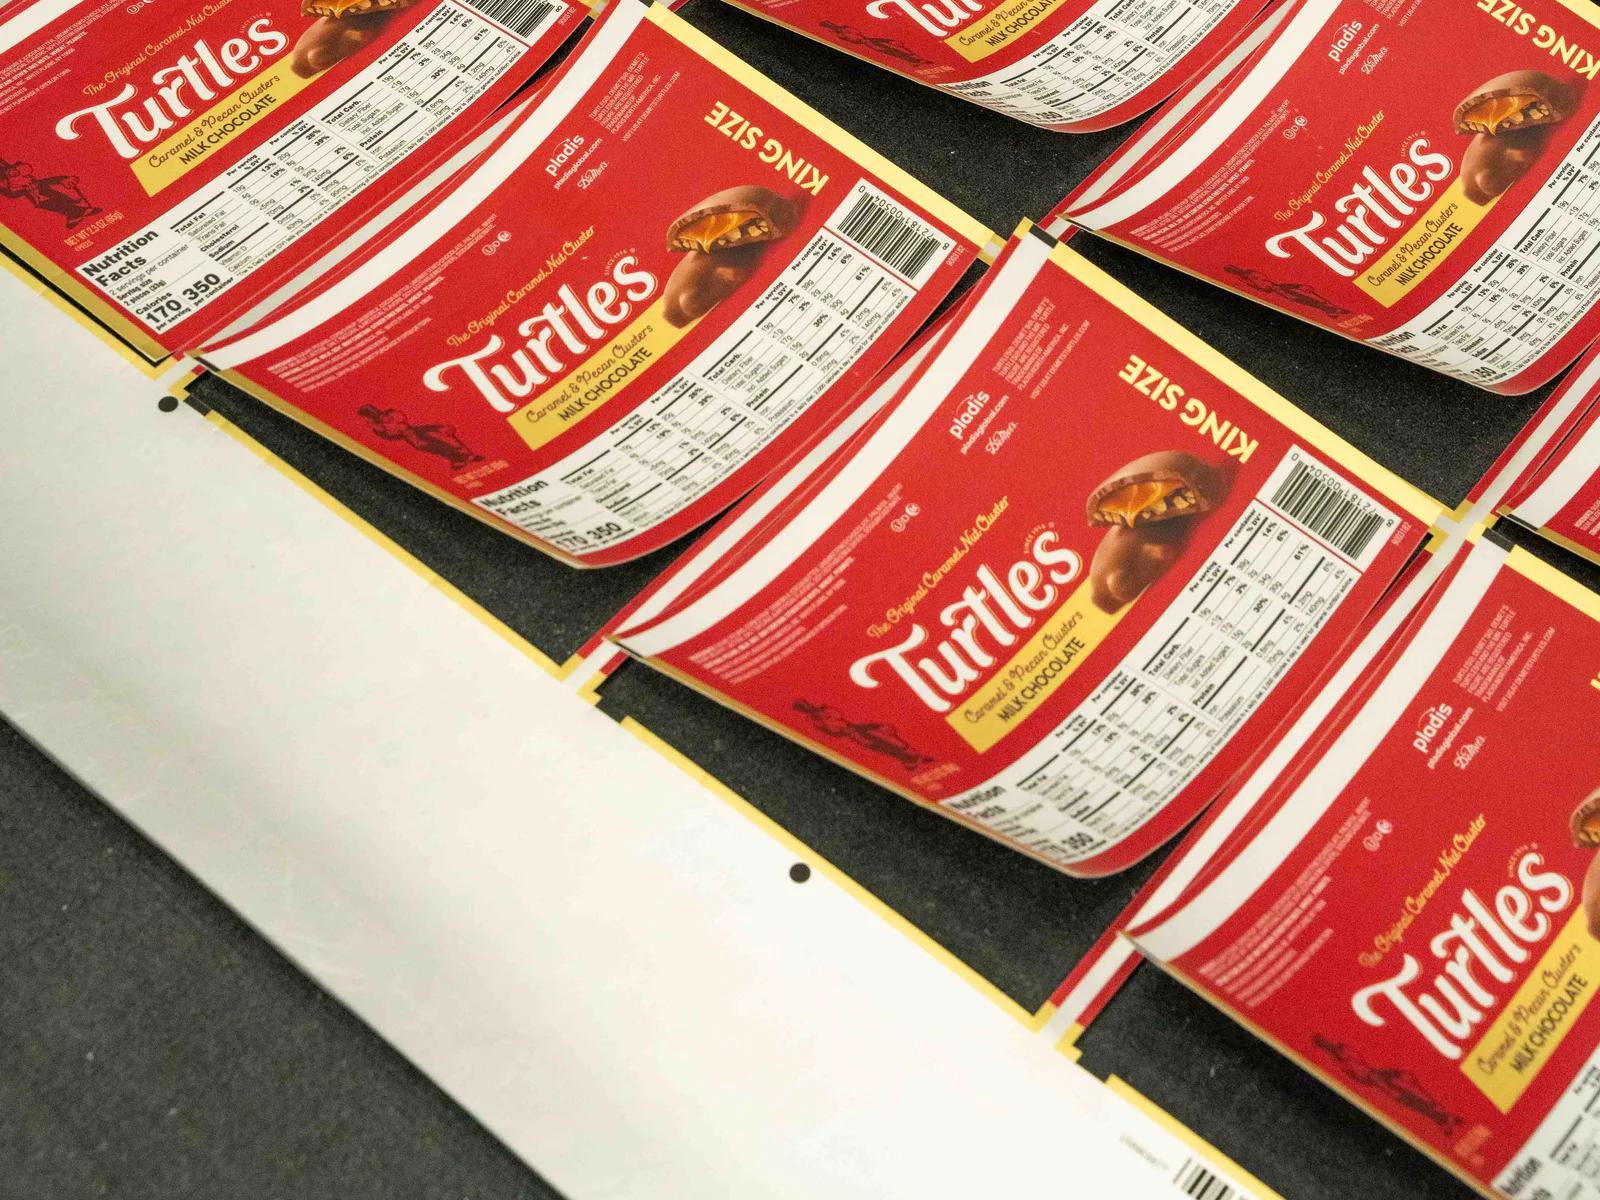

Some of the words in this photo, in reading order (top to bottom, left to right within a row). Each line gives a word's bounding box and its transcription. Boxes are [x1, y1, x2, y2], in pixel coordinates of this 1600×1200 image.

[82, 81, 107, 97] The
[104, 56, 147, 83] Original
[145, 26, 186, 56] Caramel
[184, 12, 206, 34] Nut
[959, 19, 995, 46] Caramel
[992, 14, 1001, 27] &
[985, 29, 1008, 47] MILK
[1328, 19, 1363, 62] pladis
[1339, 23, 1380, 75] pladisglobal.com
[1532, 24, 1600, 81] KING
[55, 17, 290, 160] Turtles
[325, 109, 347, 125] Total
[344, 99, 362, 114] Carb.
[149, 133, 196, 168] Caramel
[193, 126, 205, 138] &
[201, 101, 241, 129] Pecan
[238, 74, 281, 104] Clusters
[178, 139, 212, 165] MILK
[207, 93, 277, 144] CHOCOLATE
[359, 129, 384, 148] Protein
[703, 100, 764, 150] SIZE
[378, 139, 407, 161] Potassium
[545, 134, 585, 177] pladis
[553, 138, 603, 190] pladisglobal.com
[758, 138, 830, 196] KING
[1273, 206, 1294, 222] The
[1288, 181, 1322, 211] Original
[1316, 151, 1350, 184] Caramel
[1345, 137, 1363, 157] Nut
[1358, 109, 1385, 139] Cluster
[174, 217, 196, 235] Total
[193, 212, 207, 224] Fat
[1265, 138, 1453, 277] Turtles
[1425, 202, 1459, 234] Clusters
[64, 234, 79, 247] NET
[76, 230, 88, 241] WT
[97, 218, 108, 229] OZ
[82, 229, 159, 277] Nutrition
[200, 224, 240, 252] Cholesterol
[208, 240, 235, 259] Sodium
[1394, 265, 1418, 286] MILK
[1414, 222, 1464, 269] CHOCOLATE
[1399, 251, 1408, 263] &
[1400, 230, 1432, 255] Pecan
[95, 256, 147, 287] Facts
[114, 273, 146, 293] servings
[145, 262, 158, 275] per
[157, 244, 190, 267] container
[117, 284, 139, 301] Serving
[138, 278, 153, 289] size
[182, 273, 221, 301] 350
[446, 331, 471, 348] The
[467, 302, 511, 335] Original
[506, 270, 549, 305] Caramel
[545, 253, 568, 275] Nut
[562, 225, 596, 256] Cluster
[1367, 259, 1401, 287] Caramel
[135, 291, 173, 316] Calories
[145, 299, 182, 324] 170
[422, 256, 659, 413] Turtles
[525, 388, 572, 424] Caramel
[568, 382, 580, 394] &
[575, 357, 617, 385] Pecan
[611, 324, 654, 359] Clusters
[557, 398, 590, 422] MILK
[584, 346, 653, 402] CHOCOLATE
[1118, 353, 1185, 411] SIZE
[949, 390, 990, 440] pladis
[960, 393, 1010, 455] pladisglobal.com
[1179, 398, 1259, 464] KING
[479, 478, 549, 508] Nutrition
[496, 500, 541, 517] Facts
[586, 522, 622, 540] 350
[849, 530, 1083, 713] Turtles
[996, 694, 1028, 722] MILK
[1020, 636, 1086, 699] CHOCOLATE
[1412, 703, 1453, 754] pladis
[1351, 852, 1574, 1061] Turtles
[1509, 1039, 1540, 1074] MILK
[1534, 972, 1589, 1046] CHOCOLATE
